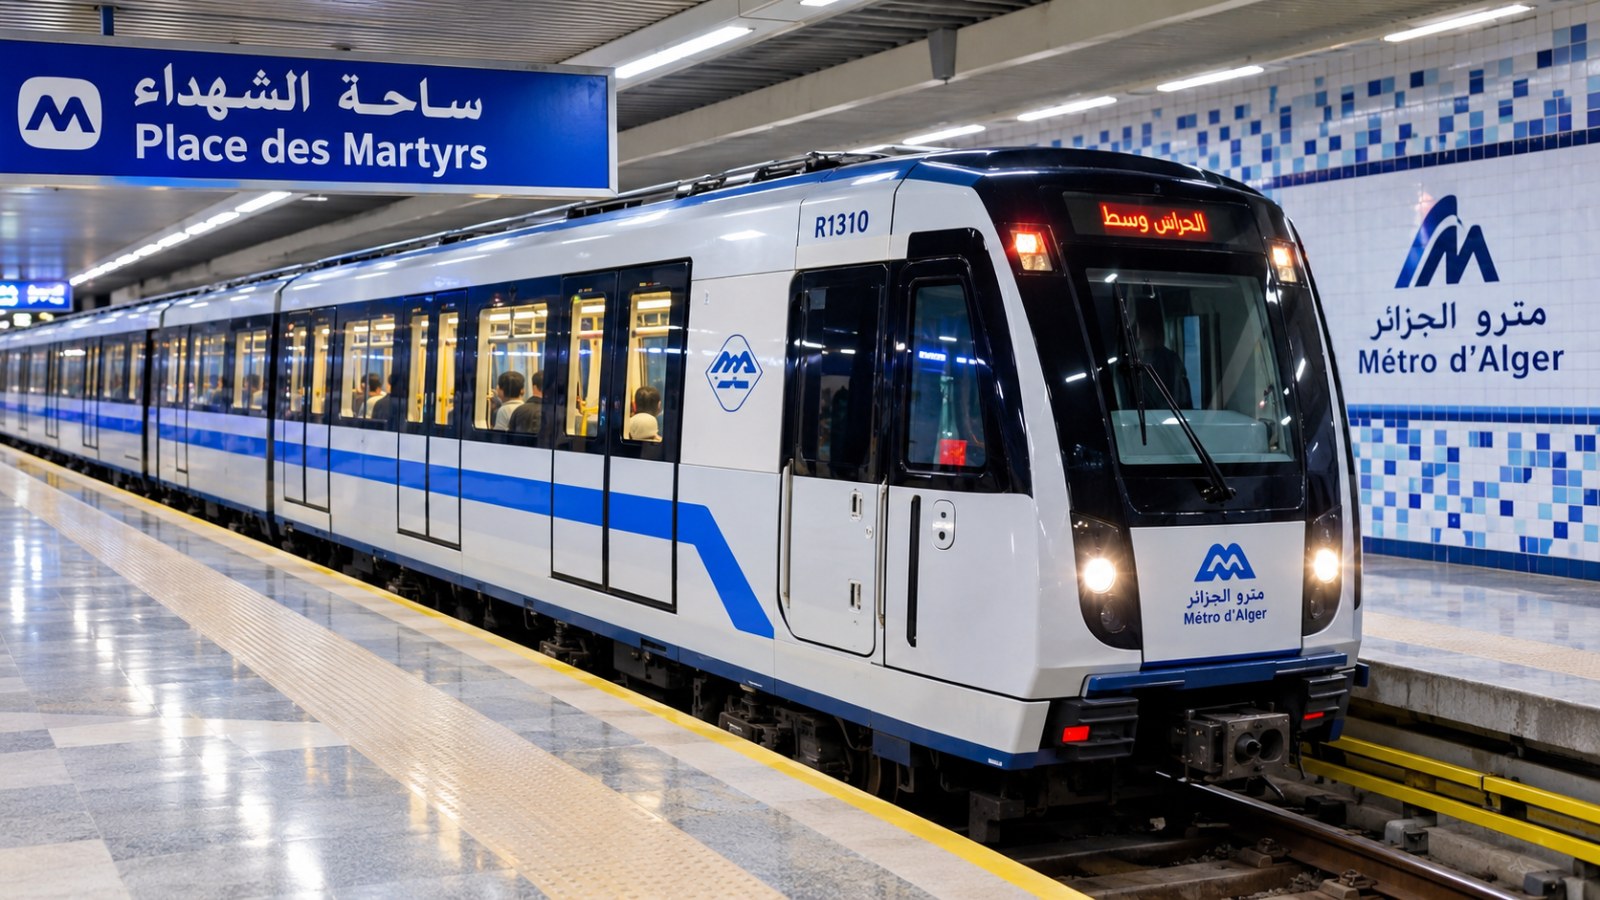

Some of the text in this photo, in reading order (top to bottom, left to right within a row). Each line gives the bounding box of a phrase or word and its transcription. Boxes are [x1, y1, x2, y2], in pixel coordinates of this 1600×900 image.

[134, 62, 483, 121] ساحة الشهداء
[136, 123, 488, 178] Place des Martyrs
[814, 209, 869, 238] R1310
[1103, 205, 1149, 233] وسط
[1369, 300, 1547, 341] مترو الجزائر
[1358, 343, 1565, 380] Métro d’Alger
[1186, 588, 1265, 609] مترو الجزائر
[1183, 607, 1267, 626] Métro d'Alger
